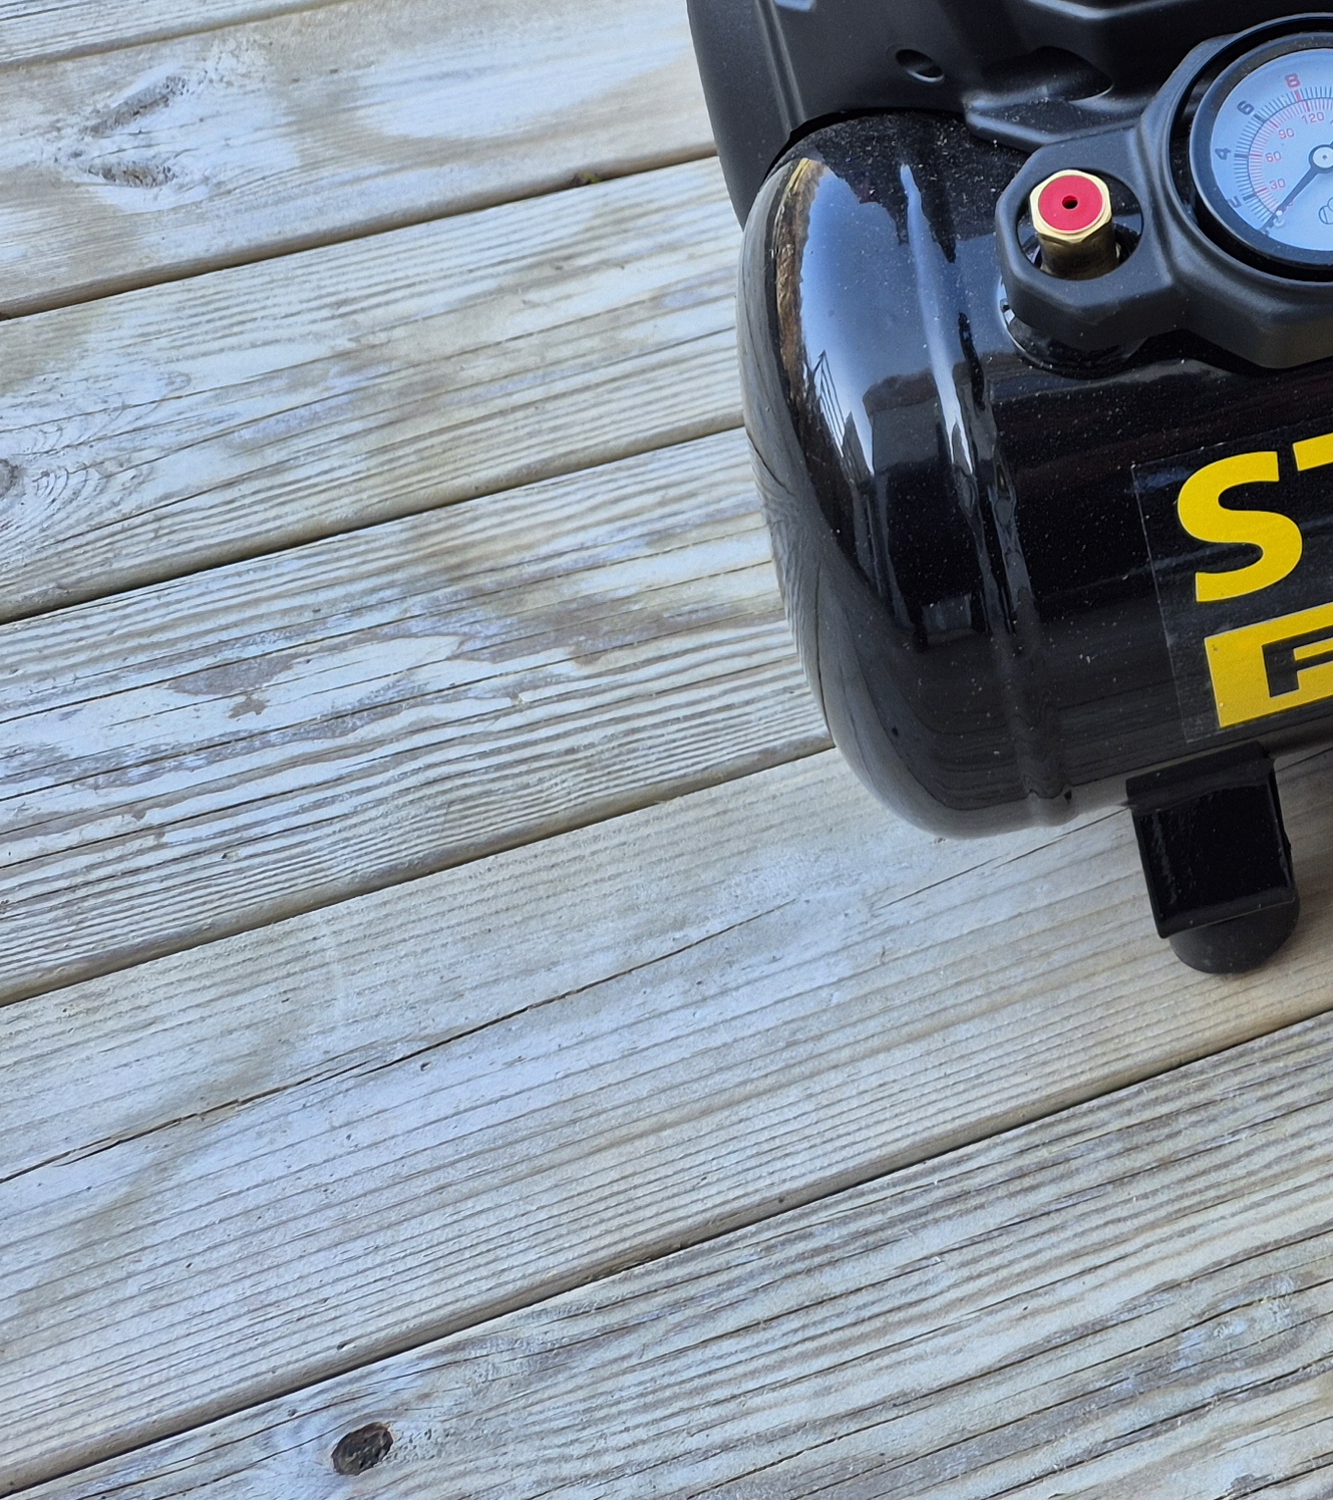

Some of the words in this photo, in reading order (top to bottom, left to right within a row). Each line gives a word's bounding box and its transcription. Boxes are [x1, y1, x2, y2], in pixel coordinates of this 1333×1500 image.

[1285, 73, 1301, 89] 8
[1237, 100, 1255, 116] 6
[1301, 111, 1325, 125] 120
[1278, 127, 1295, 140] 90
[1215, 147, 1231, 161] 4
[1265, 150, 1282, 163] 60
[1269, 178, 1286, 191] 30
